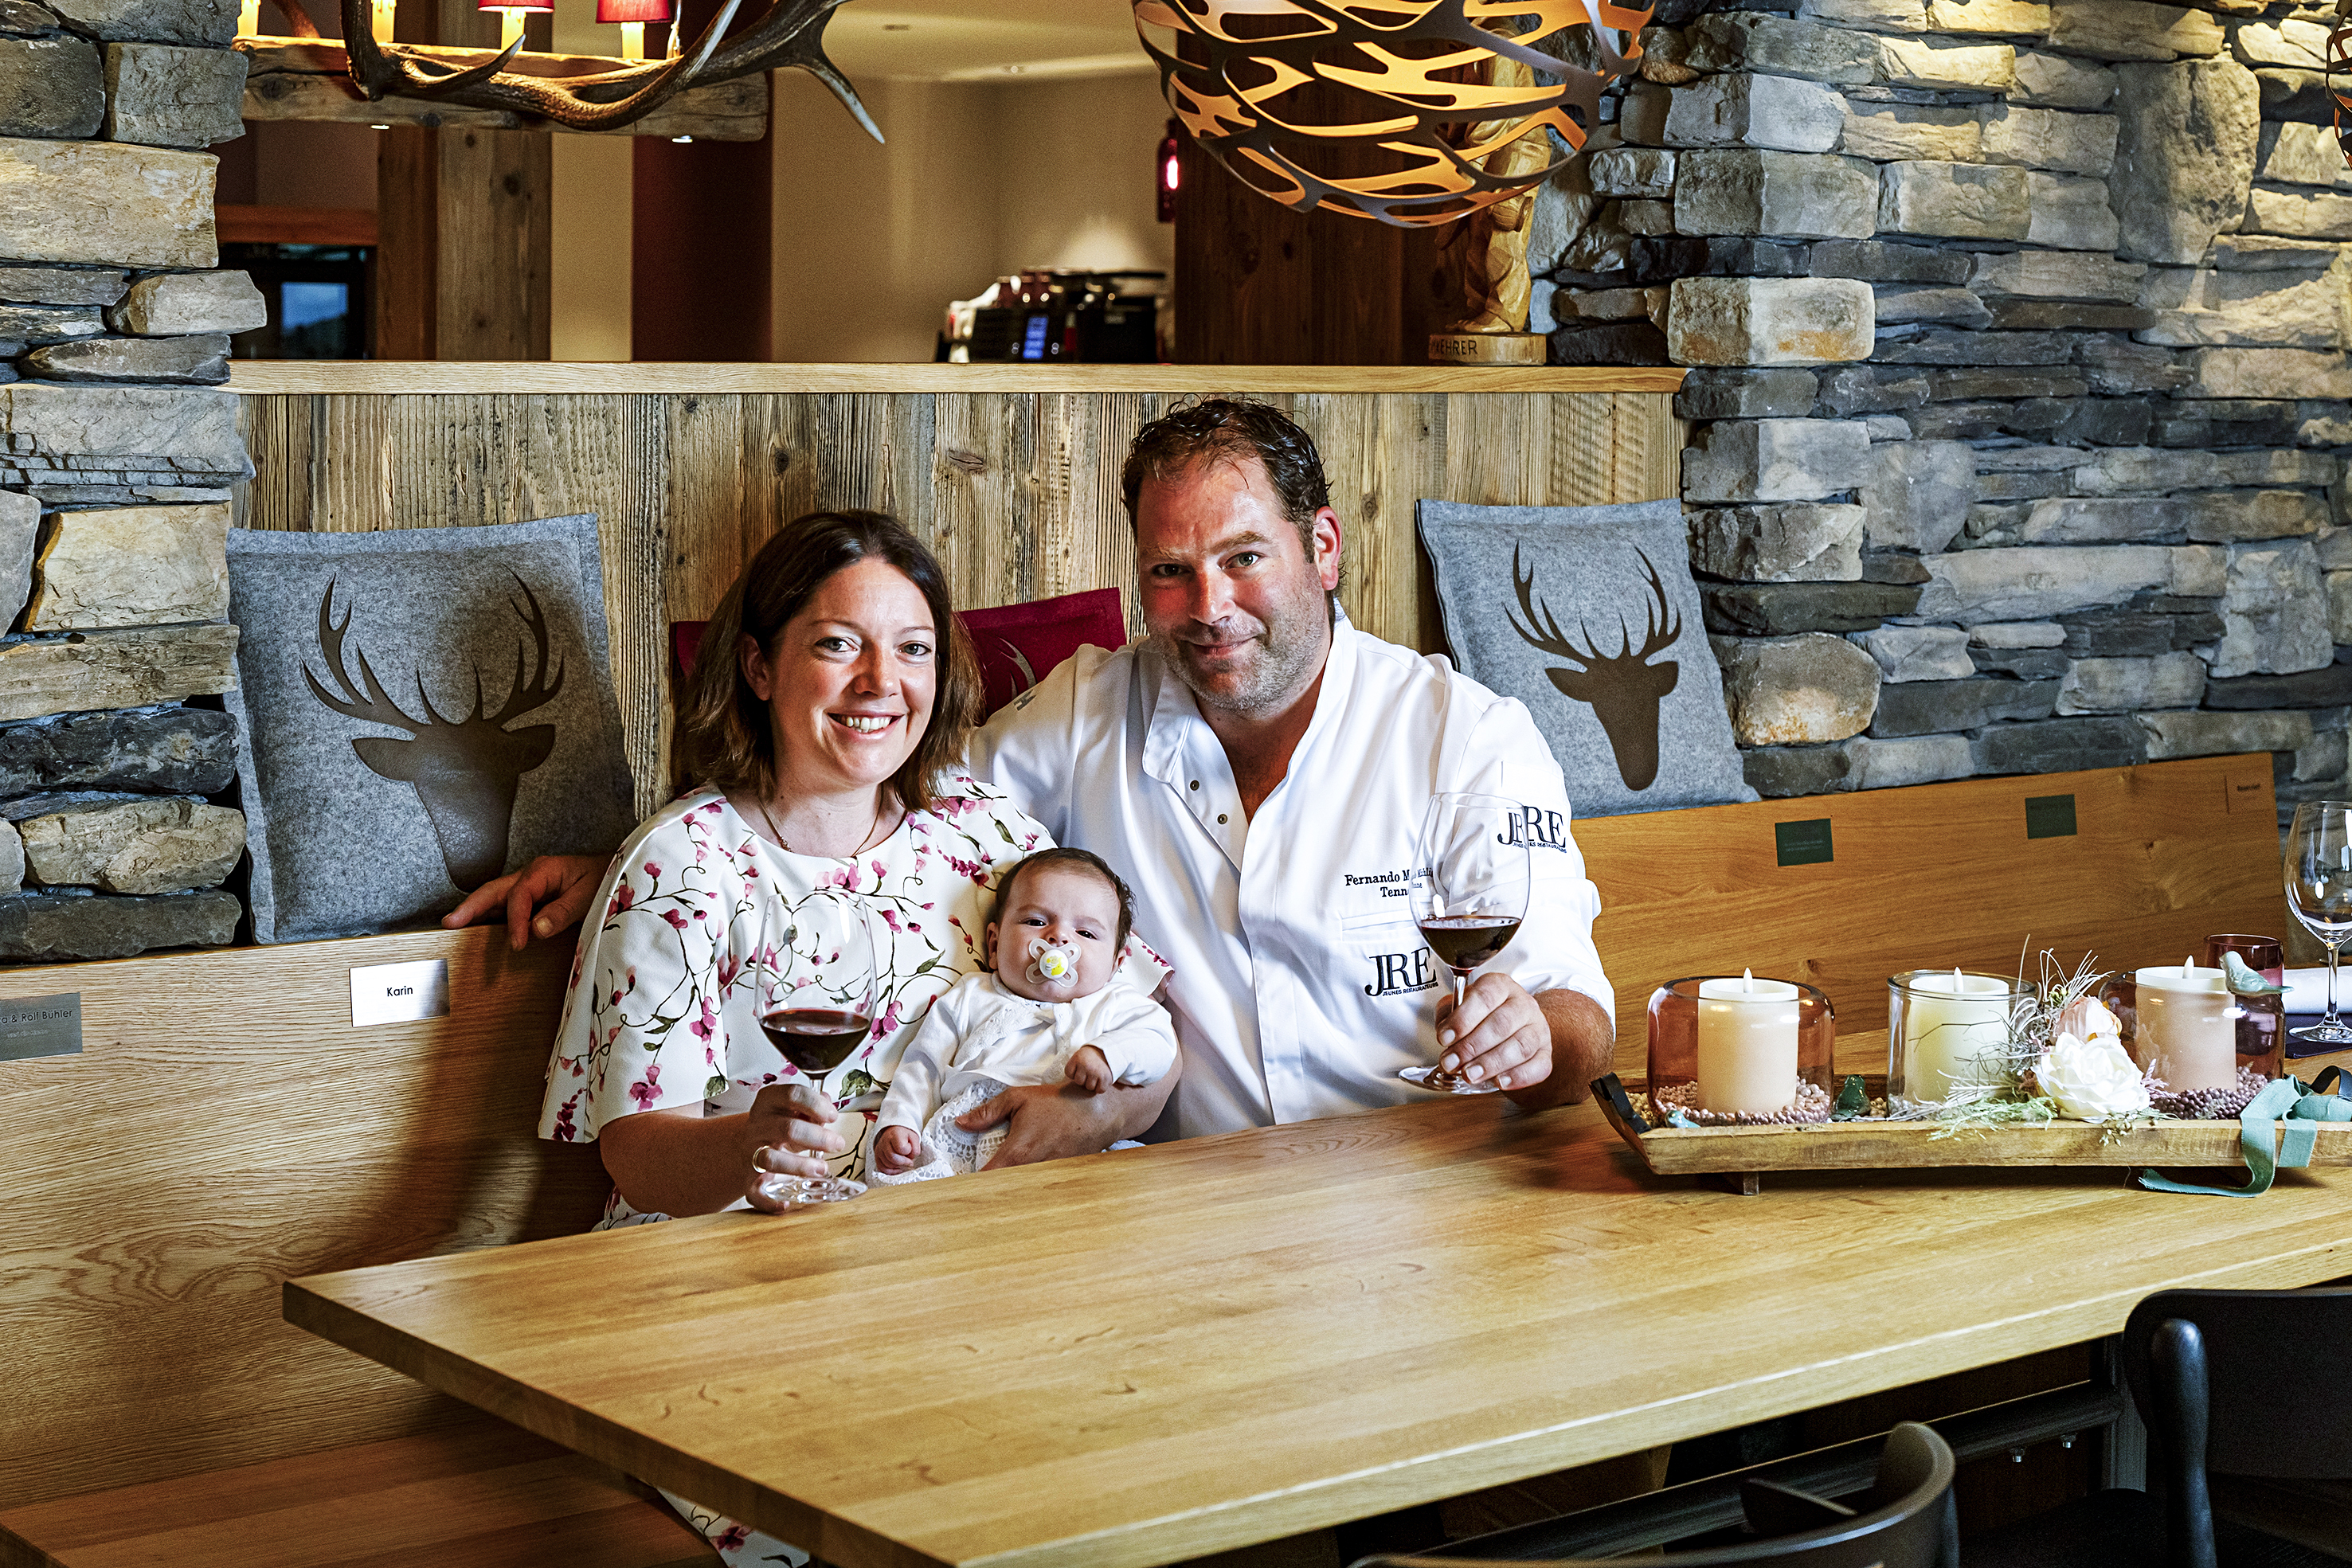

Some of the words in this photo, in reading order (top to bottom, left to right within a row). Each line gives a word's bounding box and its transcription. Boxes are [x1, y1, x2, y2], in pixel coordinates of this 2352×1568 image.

[1344, 870, 1401, 886] Fernando
[1364, 946, 1437, 996] JRE
[386, 985, 413, 997] Karin
[11, 1015, 18, 1023] &
[21, 1011, 39, 1022] Rolf
[42, 1009, 72, 1020] Bühler
